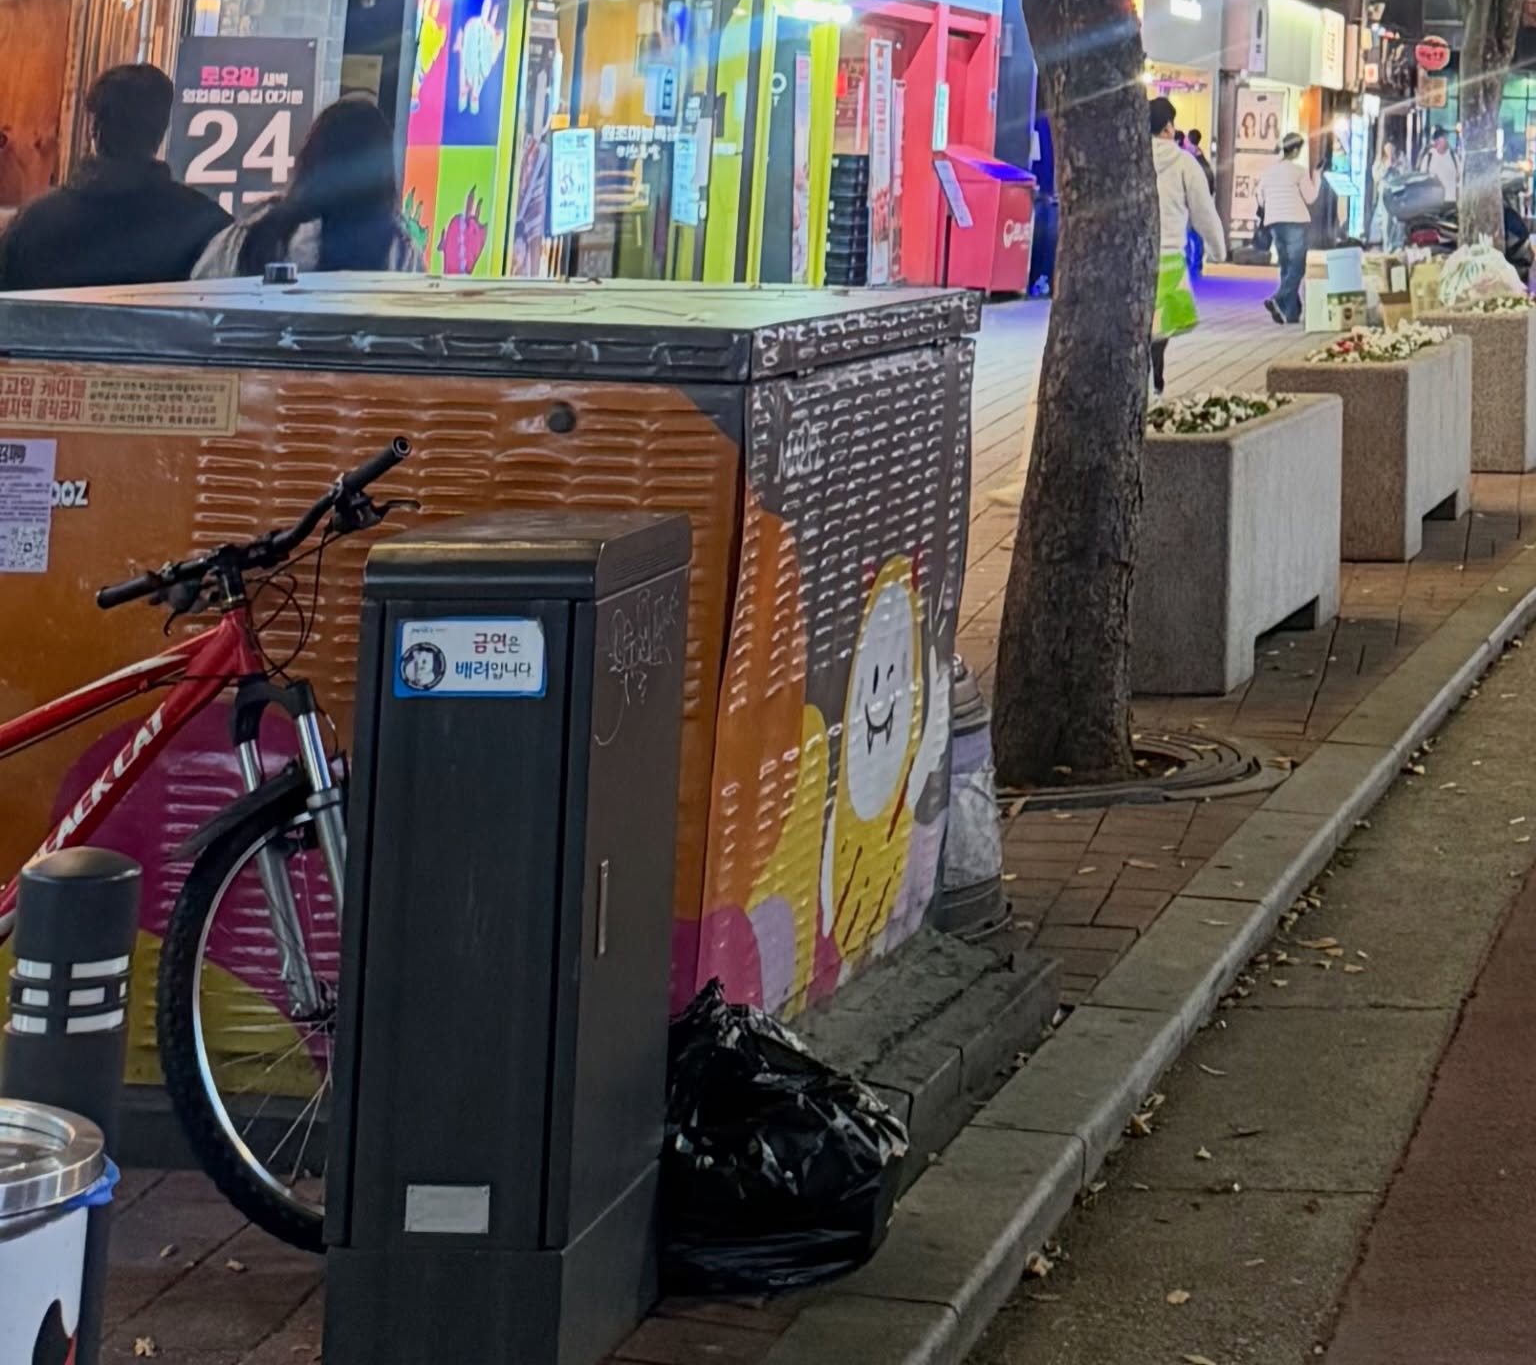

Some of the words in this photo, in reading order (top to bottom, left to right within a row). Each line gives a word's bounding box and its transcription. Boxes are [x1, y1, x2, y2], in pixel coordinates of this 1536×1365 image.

[201, 66, 259, 88] 토요일
[185, 109, 296, 184] 24
[0, 376, 34, 396] 고압
[473, 632, 521, 654] 금연은
[113, 702, 166, 779] CAT
